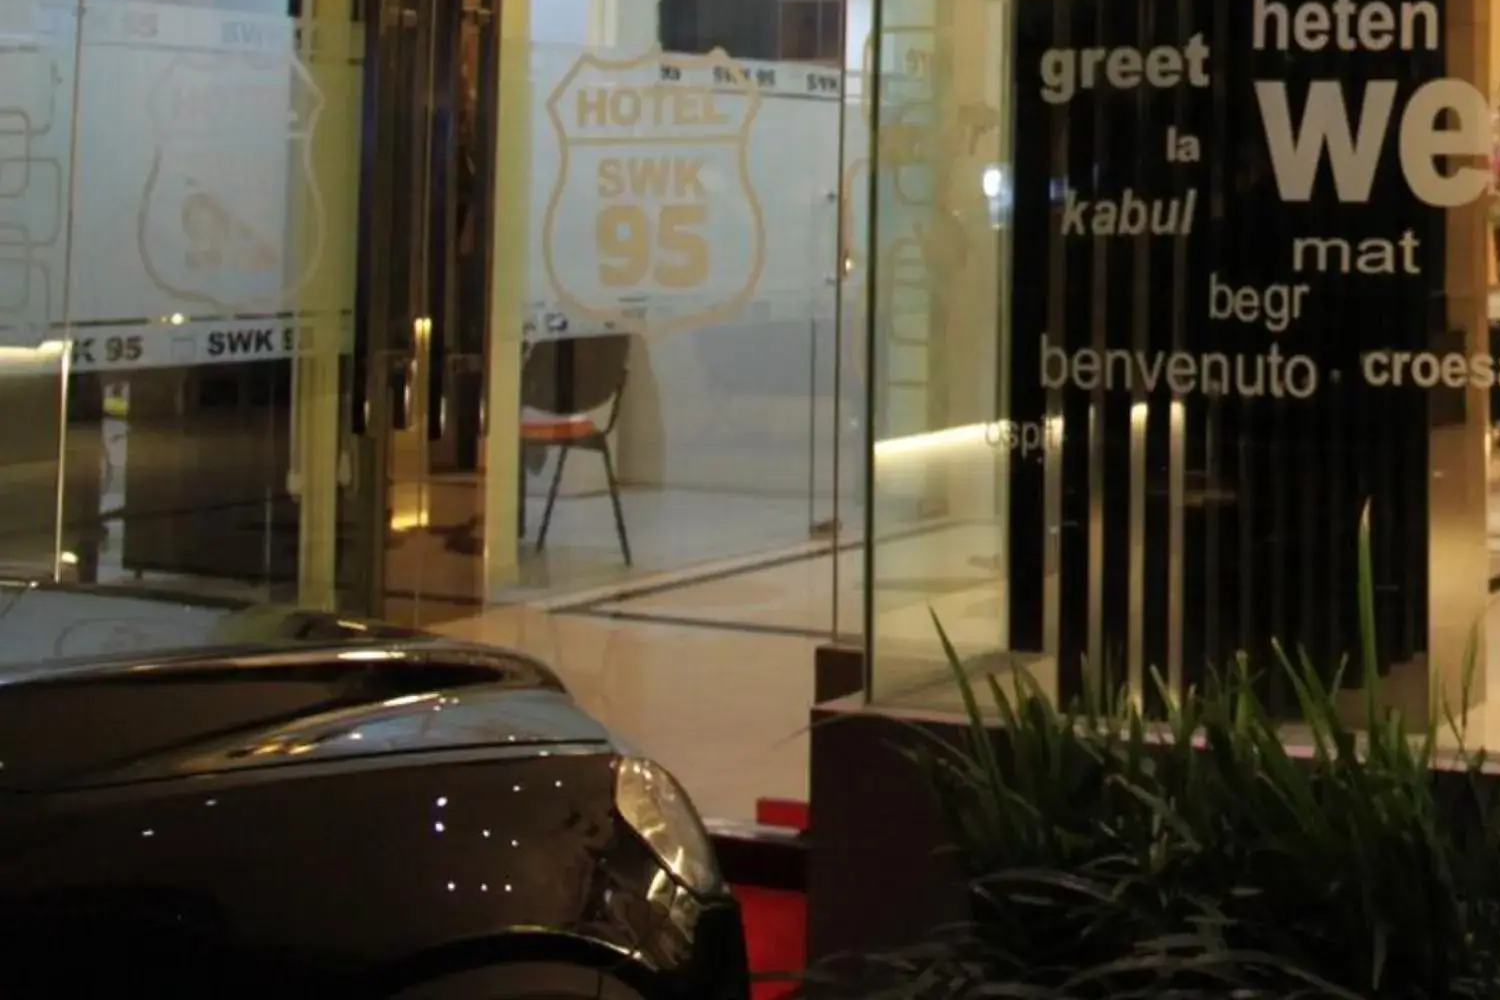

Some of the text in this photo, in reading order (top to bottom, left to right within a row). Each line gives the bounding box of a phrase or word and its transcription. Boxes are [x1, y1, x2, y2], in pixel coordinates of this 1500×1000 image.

[1040, 32, 1212, 105] greet
[577, 86, 730, 127] HOTEL
[1167, 126, 1200, 163] la
[597, 156, 707, 198] SWK
[1060, 188, 1199, 237] kabul
[596, 204, 710, 288] 95
[1293, 229, 1422, 276] mat
[1208, 276, 1311, 333] begr
[207, 328, 274, 357] SWK
[1040, 333, 1319, 400] benvenuto
